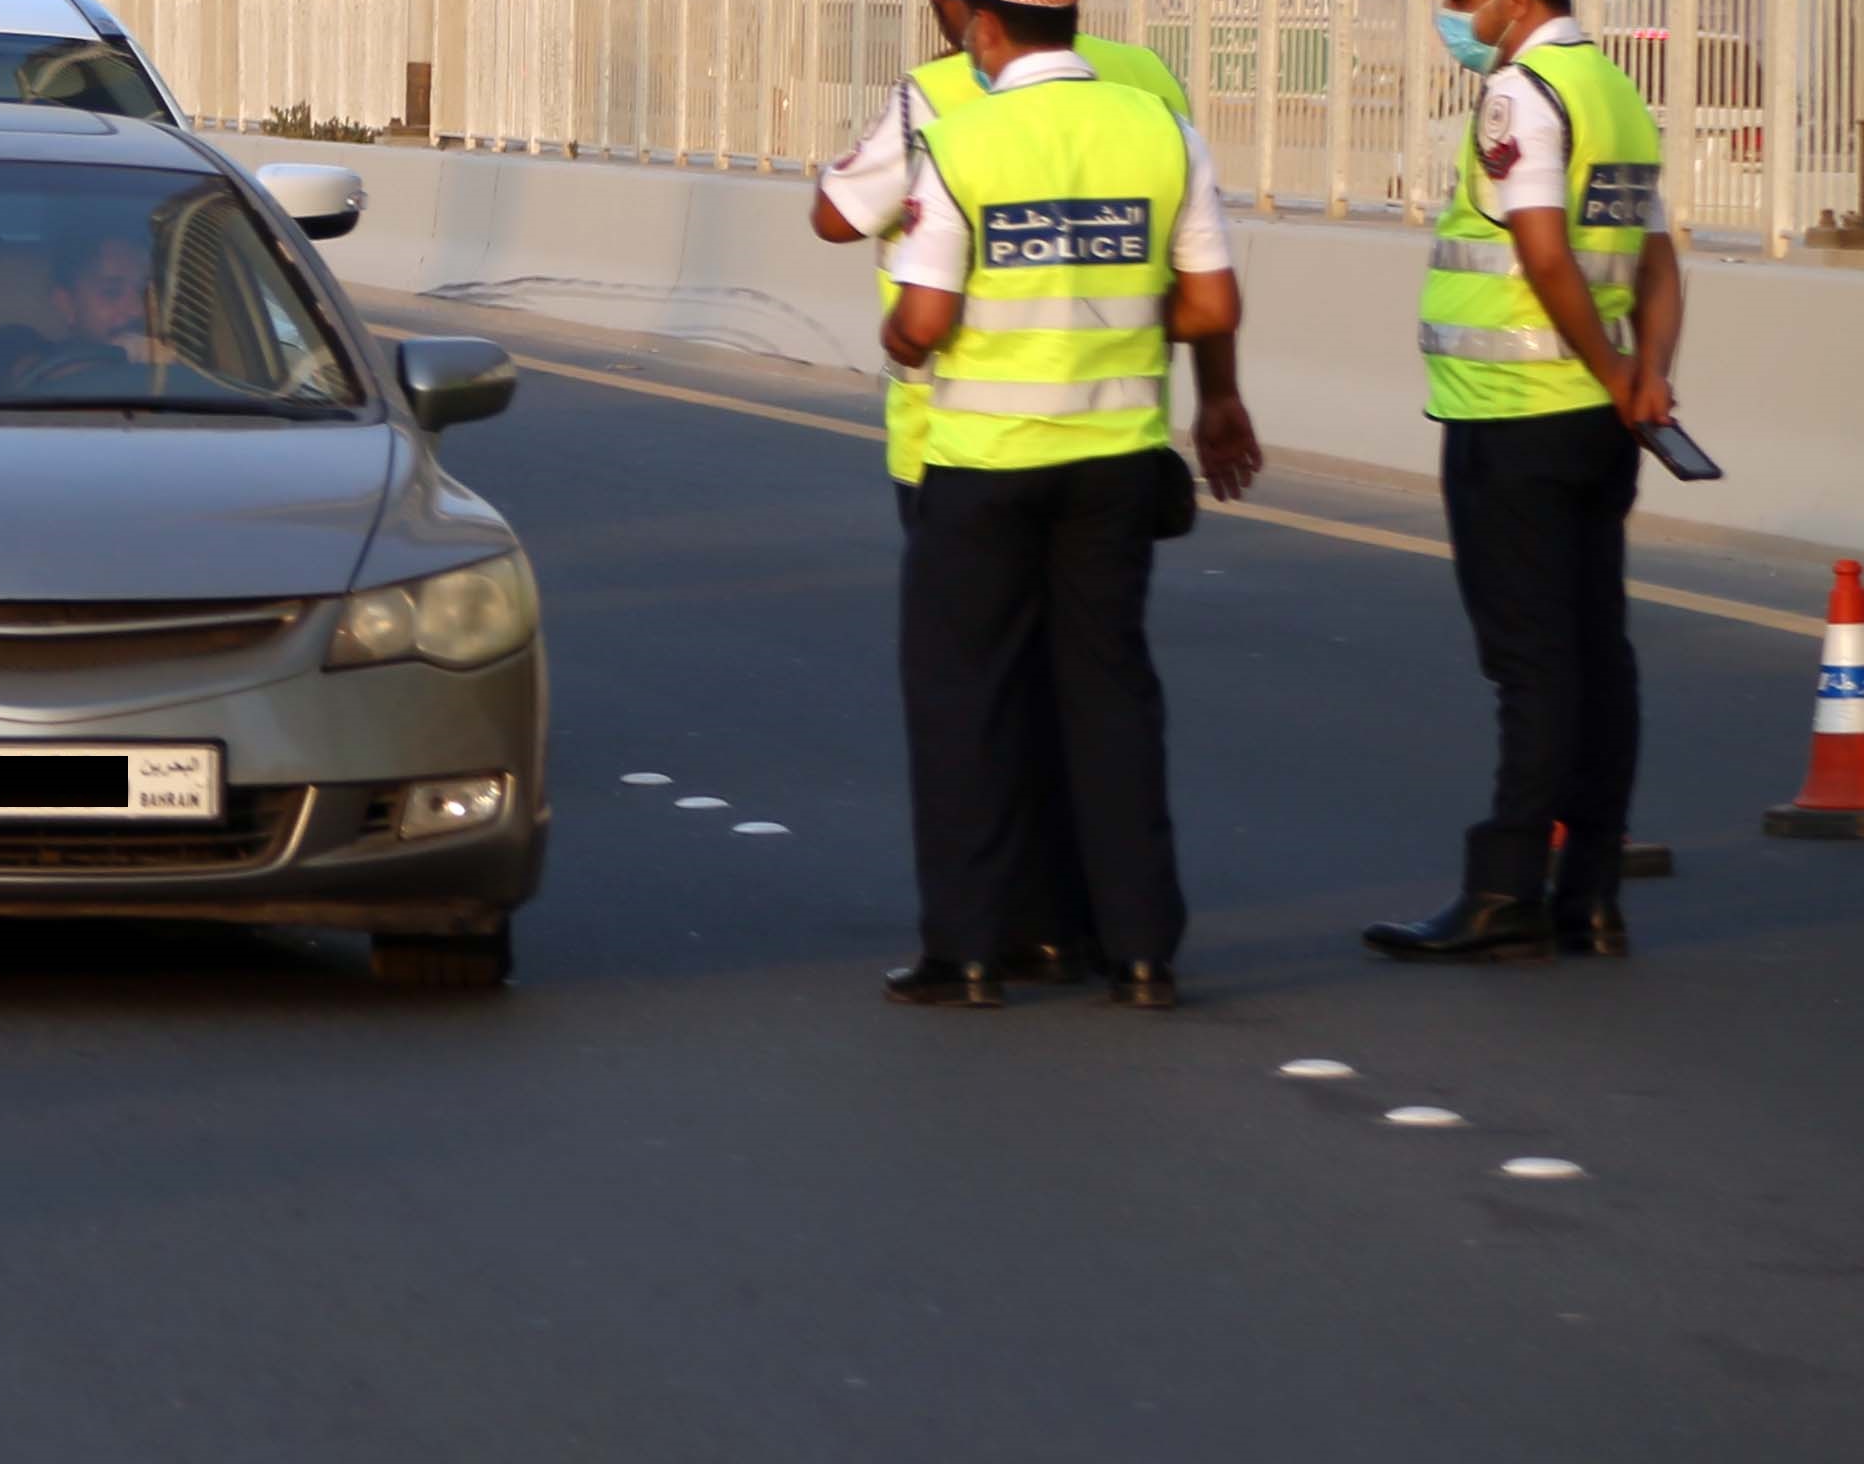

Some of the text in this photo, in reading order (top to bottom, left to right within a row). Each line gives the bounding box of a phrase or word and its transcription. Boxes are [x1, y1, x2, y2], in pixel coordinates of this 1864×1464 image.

[988, 203, 1145, 233] الشرطة
[990, 236, 1145, 264] POLICE
[139, 791, 200, 809] BAHRAIN
